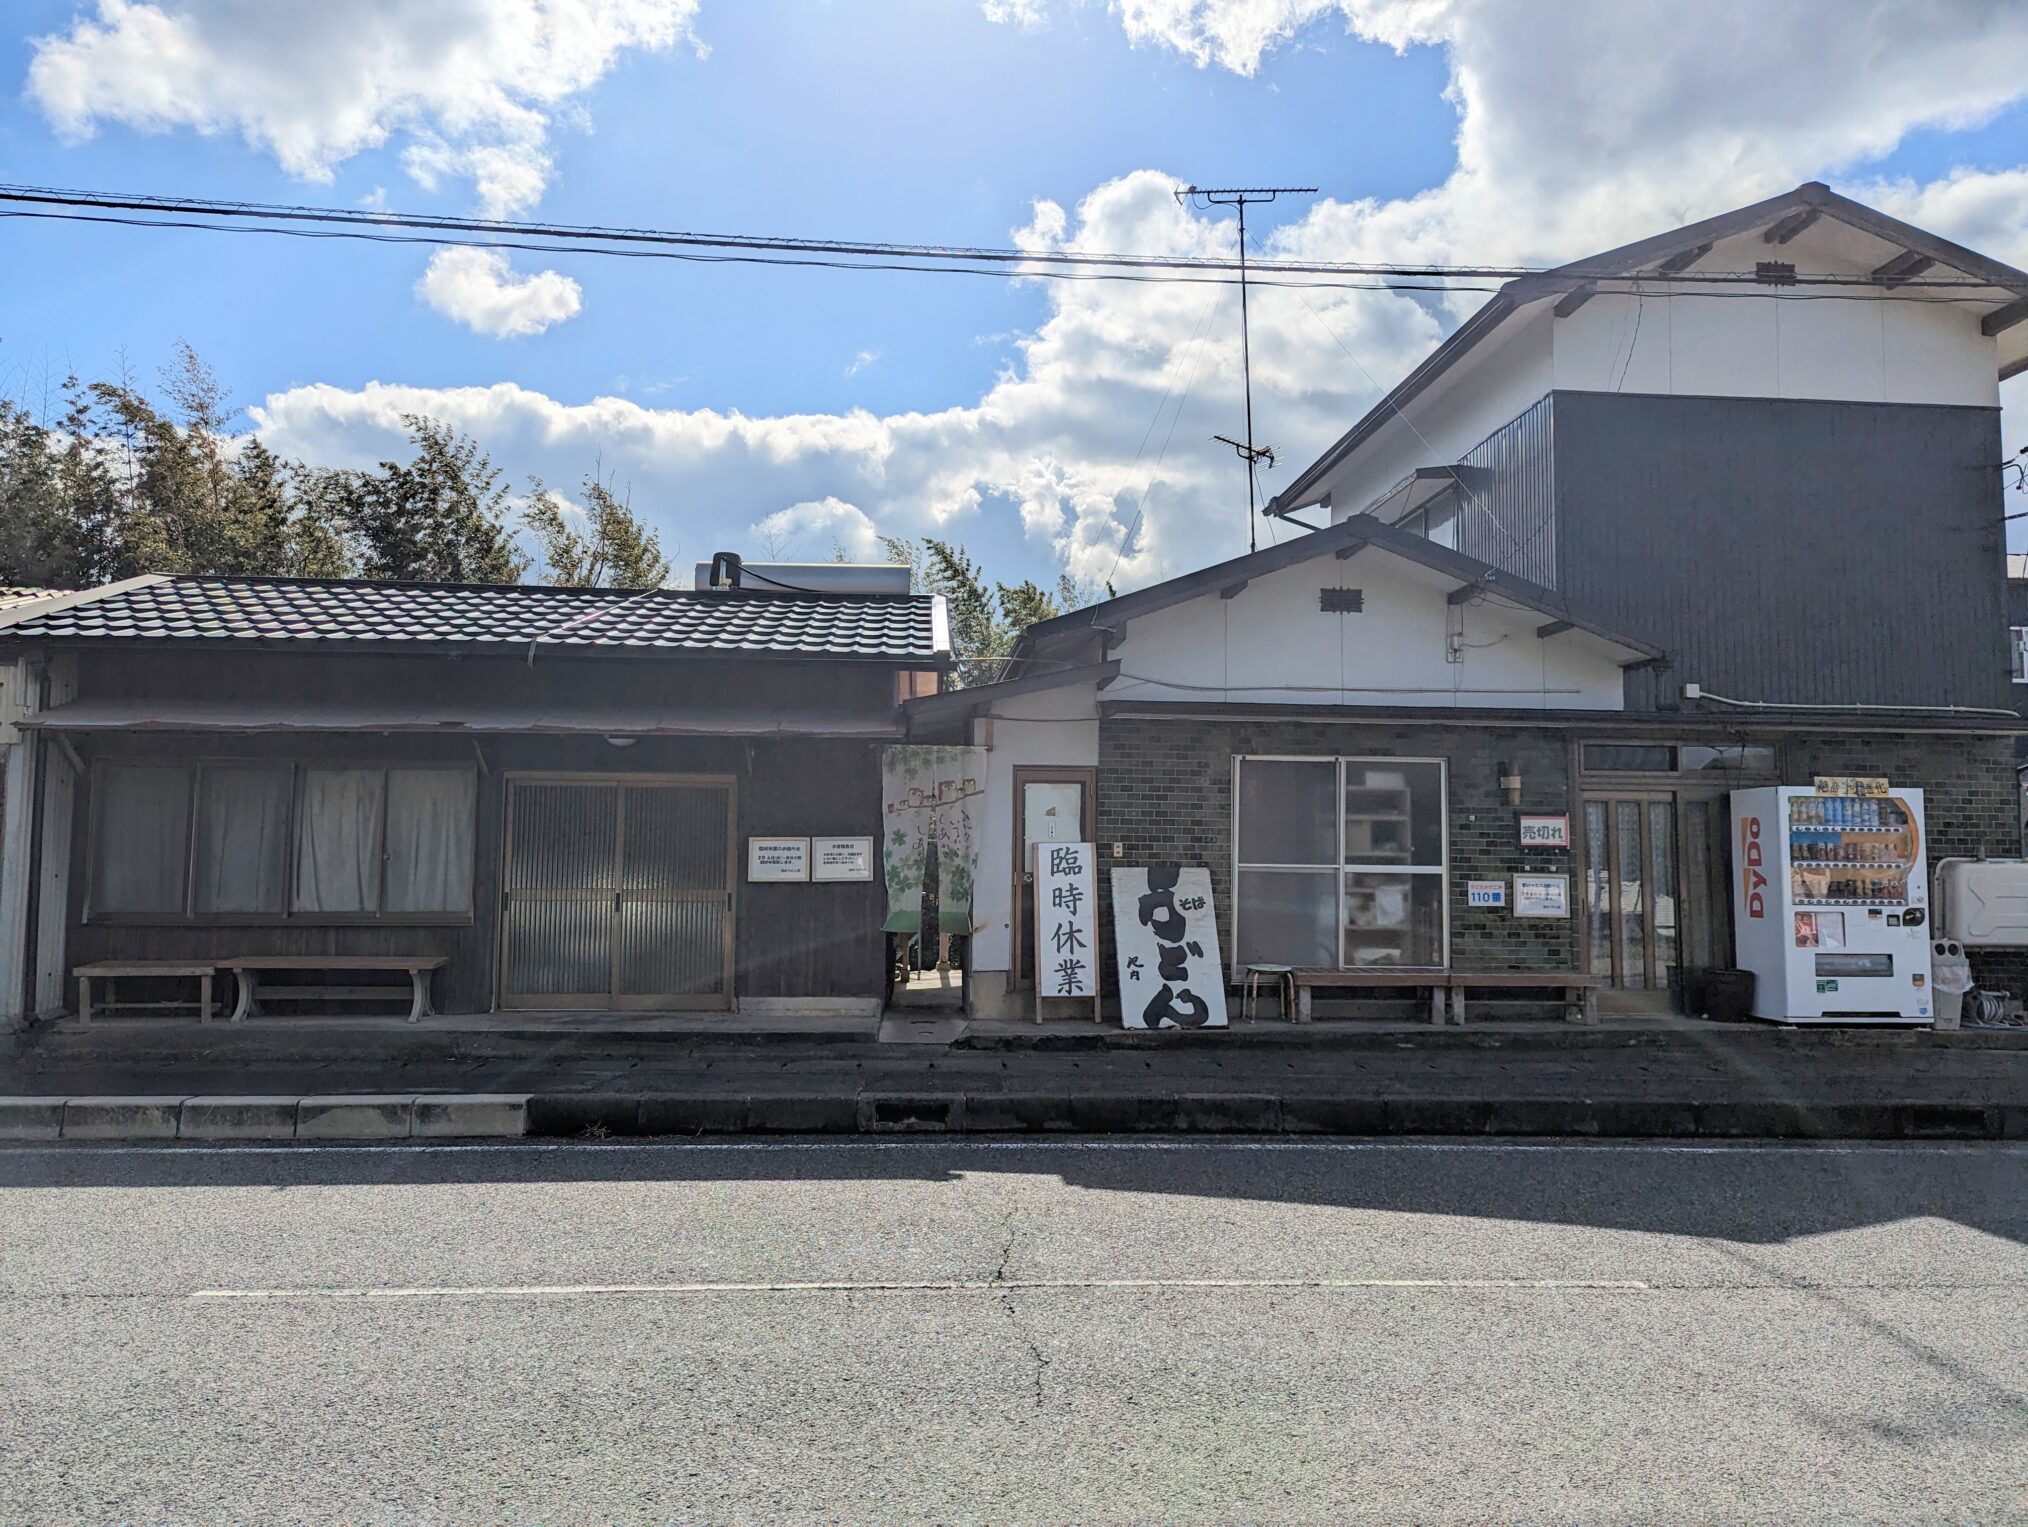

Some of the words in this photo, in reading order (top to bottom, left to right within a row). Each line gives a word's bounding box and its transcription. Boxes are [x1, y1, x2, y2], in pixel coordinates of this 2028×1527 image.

[1522, 825, 1564, 840] 売切れ
[1050, 846, 1088, 996] 臨時休業
[1178, 895, 1207, 912] そば
[1138, 866, 1209, 1029] うどん
